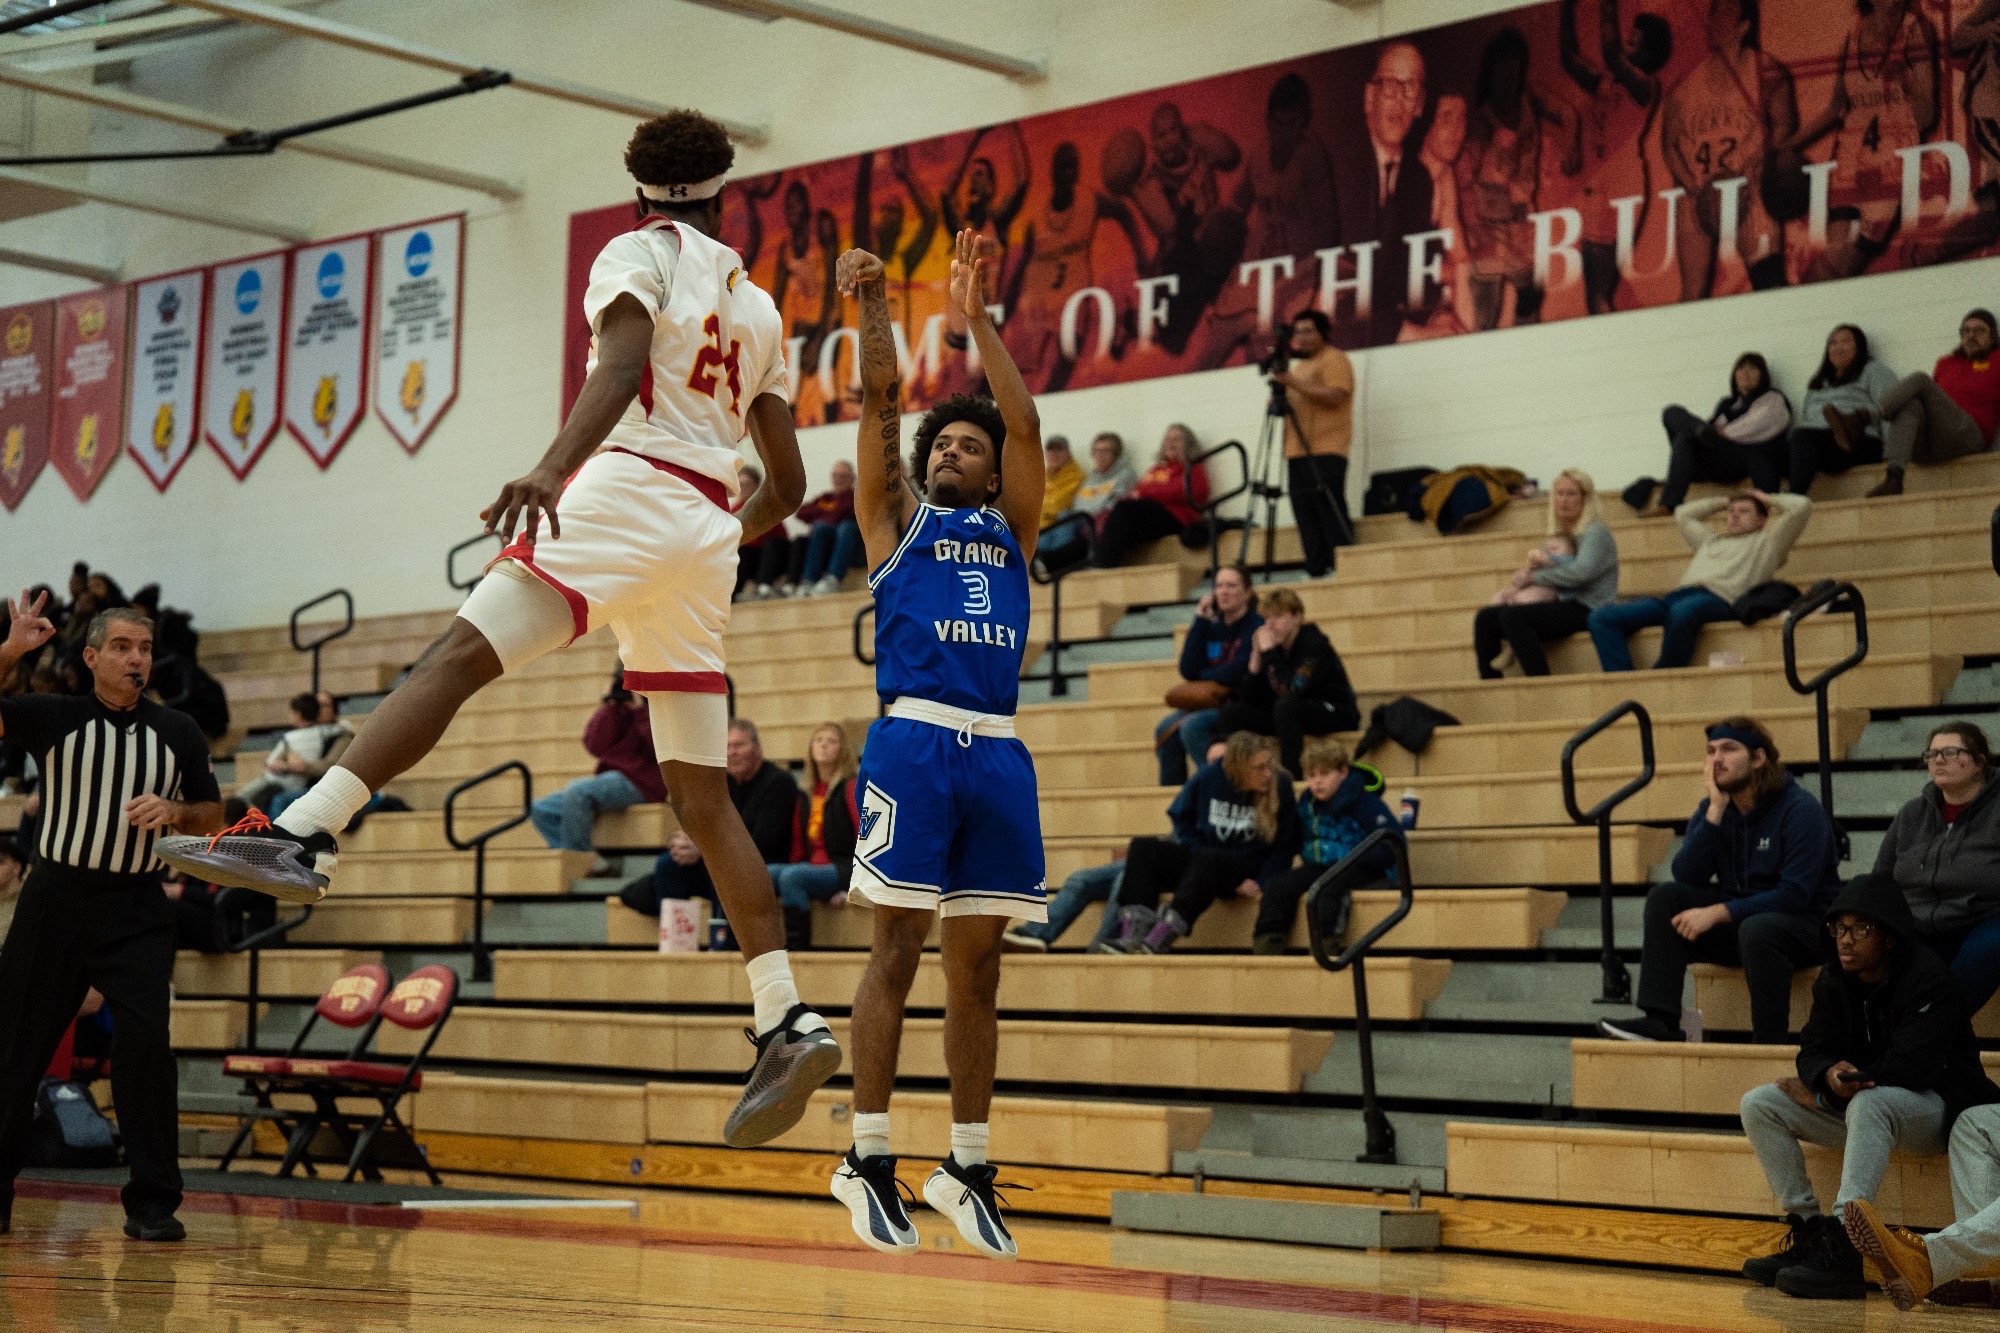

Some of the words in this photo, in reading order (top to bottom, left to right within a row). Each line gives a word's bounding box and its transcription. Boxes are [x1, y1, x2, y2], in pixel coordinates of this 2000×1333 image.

[1059, 273, 1179, 360] OF
[1239, 227, 1454, 333] THE
[1528, 140, 1972, 288] BULLD
[933, 538, 1009, 569] GRAND
[957, 570, 992, 615] 3
[933, 619, 1016, 650] VALLEY
